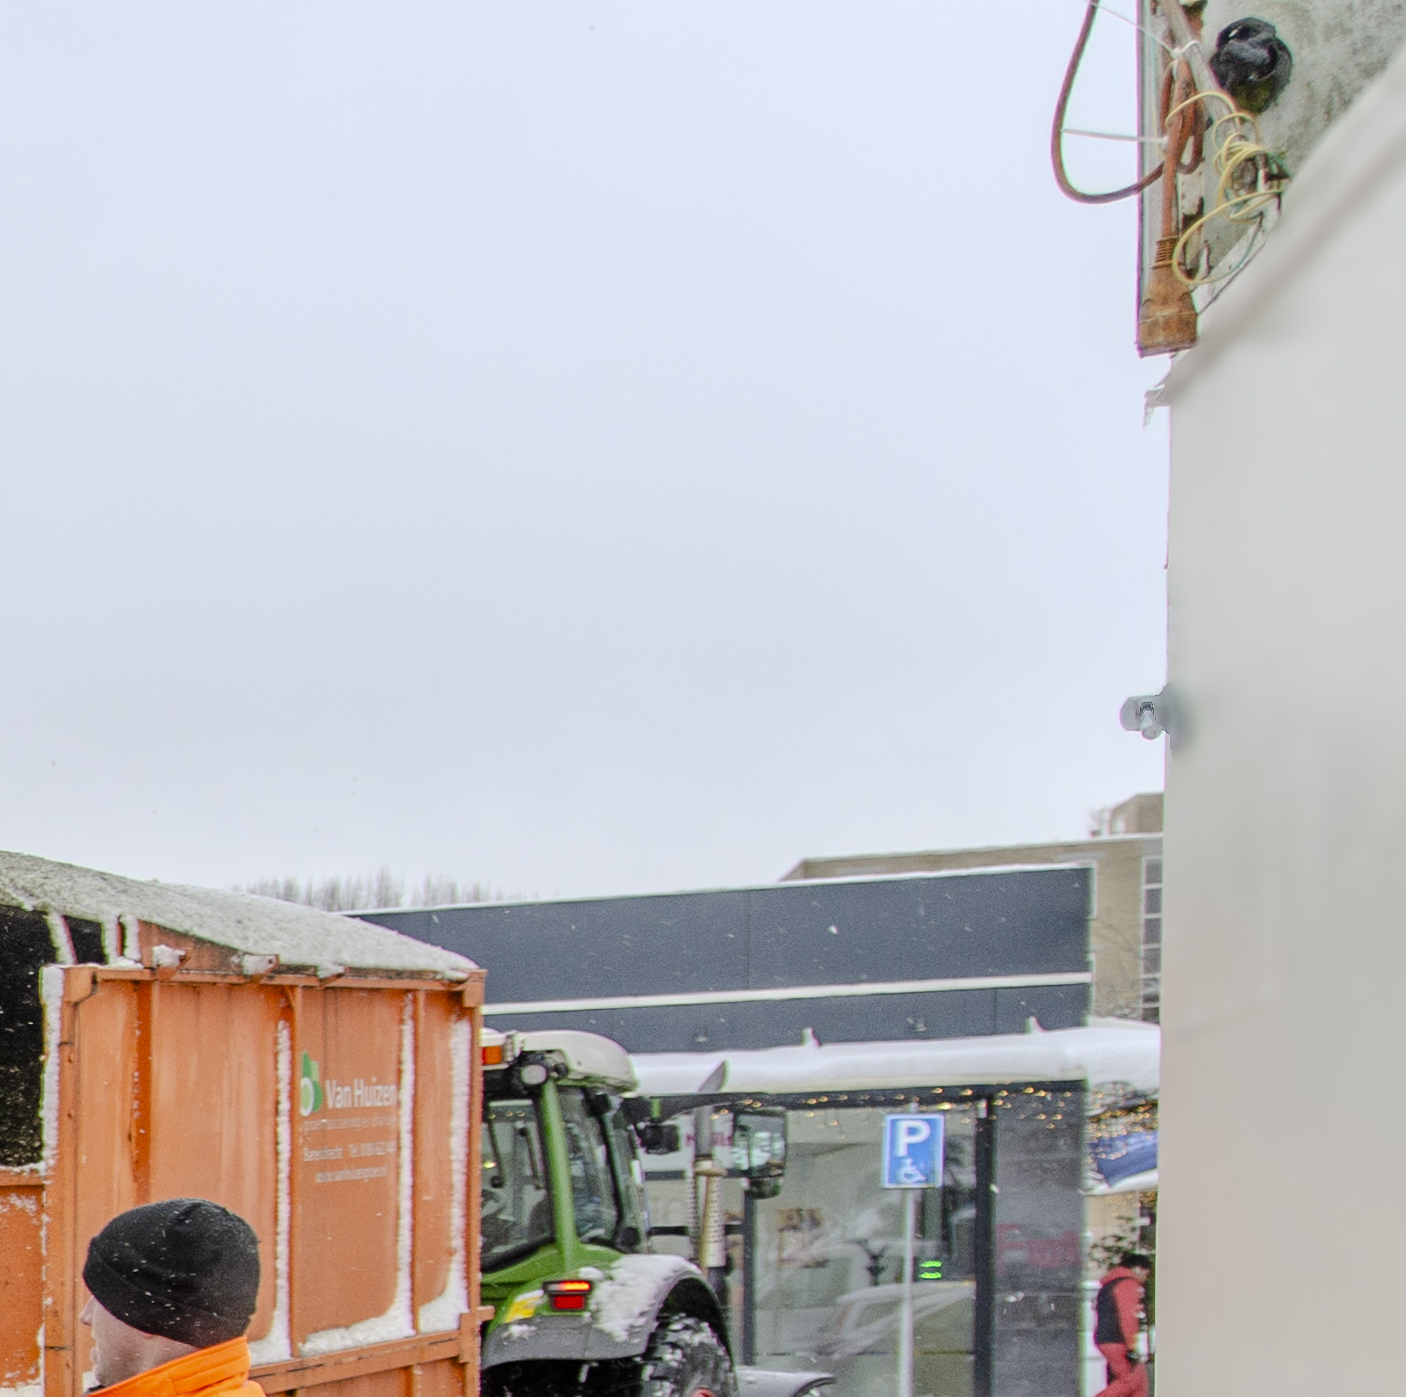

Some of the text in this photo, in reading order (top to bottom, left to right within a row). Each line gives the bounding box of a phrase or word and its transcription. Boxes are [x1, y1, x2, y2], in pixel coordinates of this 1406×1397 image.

[325, 1076, 397, 1109] Van Huizen
[896, 1120, 931, 1157] P
